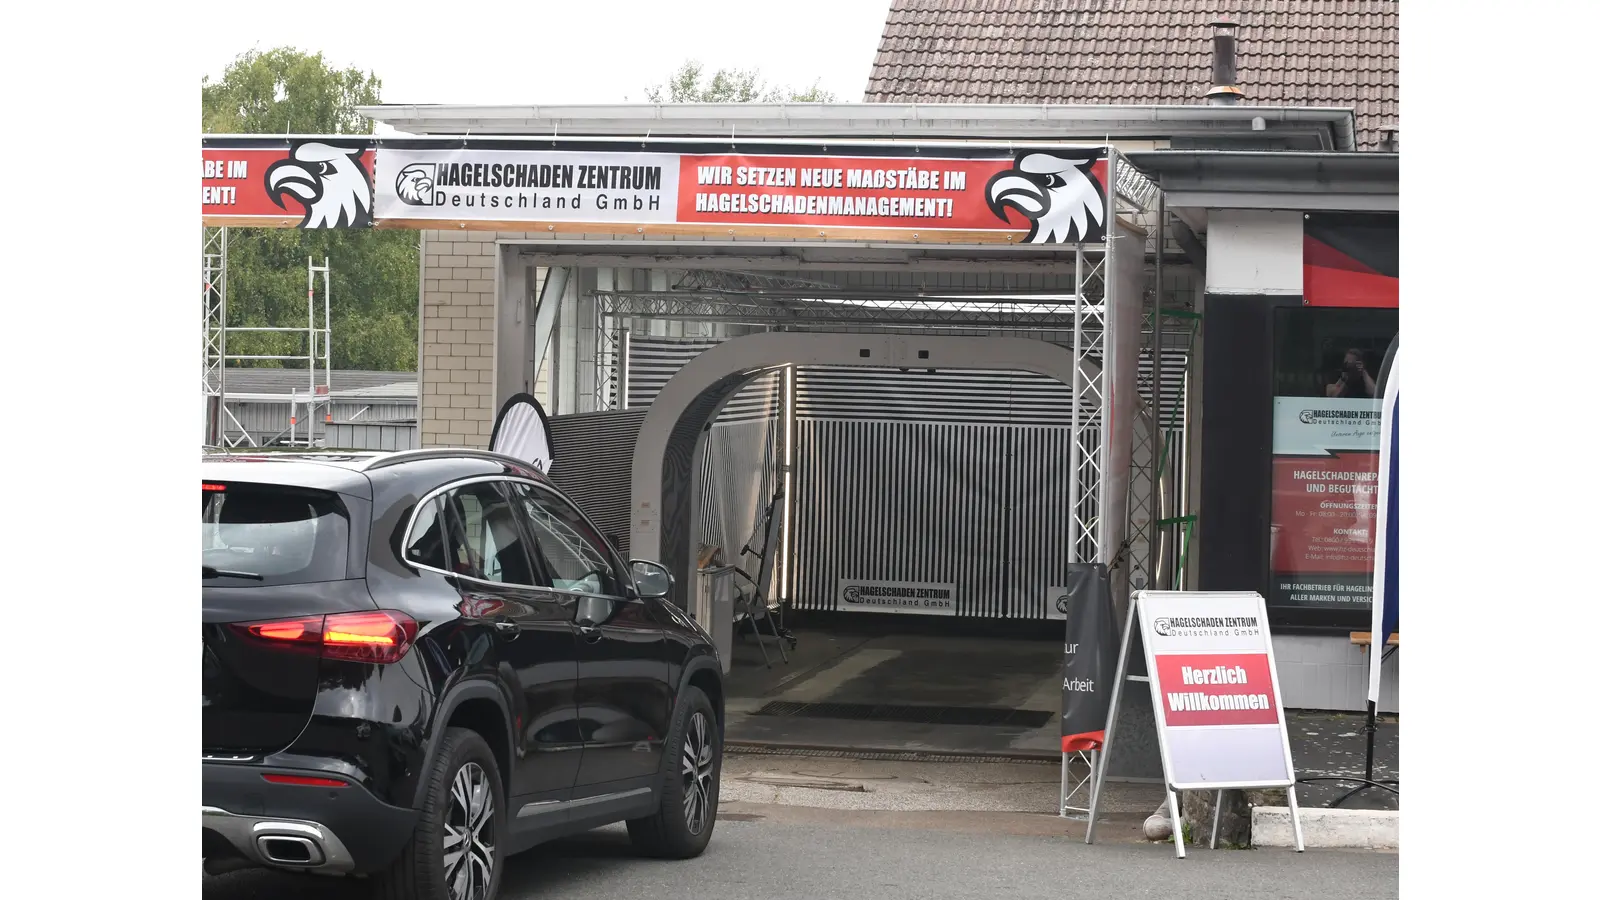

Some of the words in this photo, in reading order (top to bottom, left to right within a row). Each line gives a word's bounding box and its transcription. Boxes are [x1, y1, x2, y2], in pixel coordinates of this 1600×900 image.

[227, 160, 247, 179] IM
[437, 163, 574, 188] HAGELSCHADEN
[577, 165, 662, 189] ZENTRUM
[697, 166, 733, 186] WIR
[736, 167, 797, 187] SETZEN
[801, 168, 843, 188] NEUE
[846, 167, 940, 190] MAßSTÄBE
[943, 171, 967, 191] IM
[436, 190, 581, 209] Deutschland
[596, 193, 660, 210] GmbH
[695, 193, 954, 218] HAGELSCHADENMANAGEMENT!
[1313, 410, 1359, 419] HAGELSCHADEN
[1294, 470, 1379, 481] HAGELSCHADENREP
[1306, 484, 1326, 493] UND
[1333, 528, 1369, 537] KONTAKT:
[860, 586, 915, 598] HAGELSCHADEN
[916, 588, 950, 599] ZENTRUM
[1293, 584, 1332, 592] FACHBETRIEB
[1333, 583, 1345, 592] FÜR
[860, 597, 919, 606] Deutschland
[923, 599, 950, 607] GmbH
[1290, 593, 1308, 601] ALLER
[1309, 594, 1336, 602] MARKEN
[1170, 617, 1224, 628] HAGELSCHADEN
[1225, 617, 1258, 627] ZENTRUM
[1171, 629, 1229, 637] Deutschland
[1234, 628, 1260, 636] GmbH
[1181, 665, 1248, 685] Herzlich
[1062, 676, 1095, 693] Arbeit
[1167, 692, 1270, 712] Willkommen
